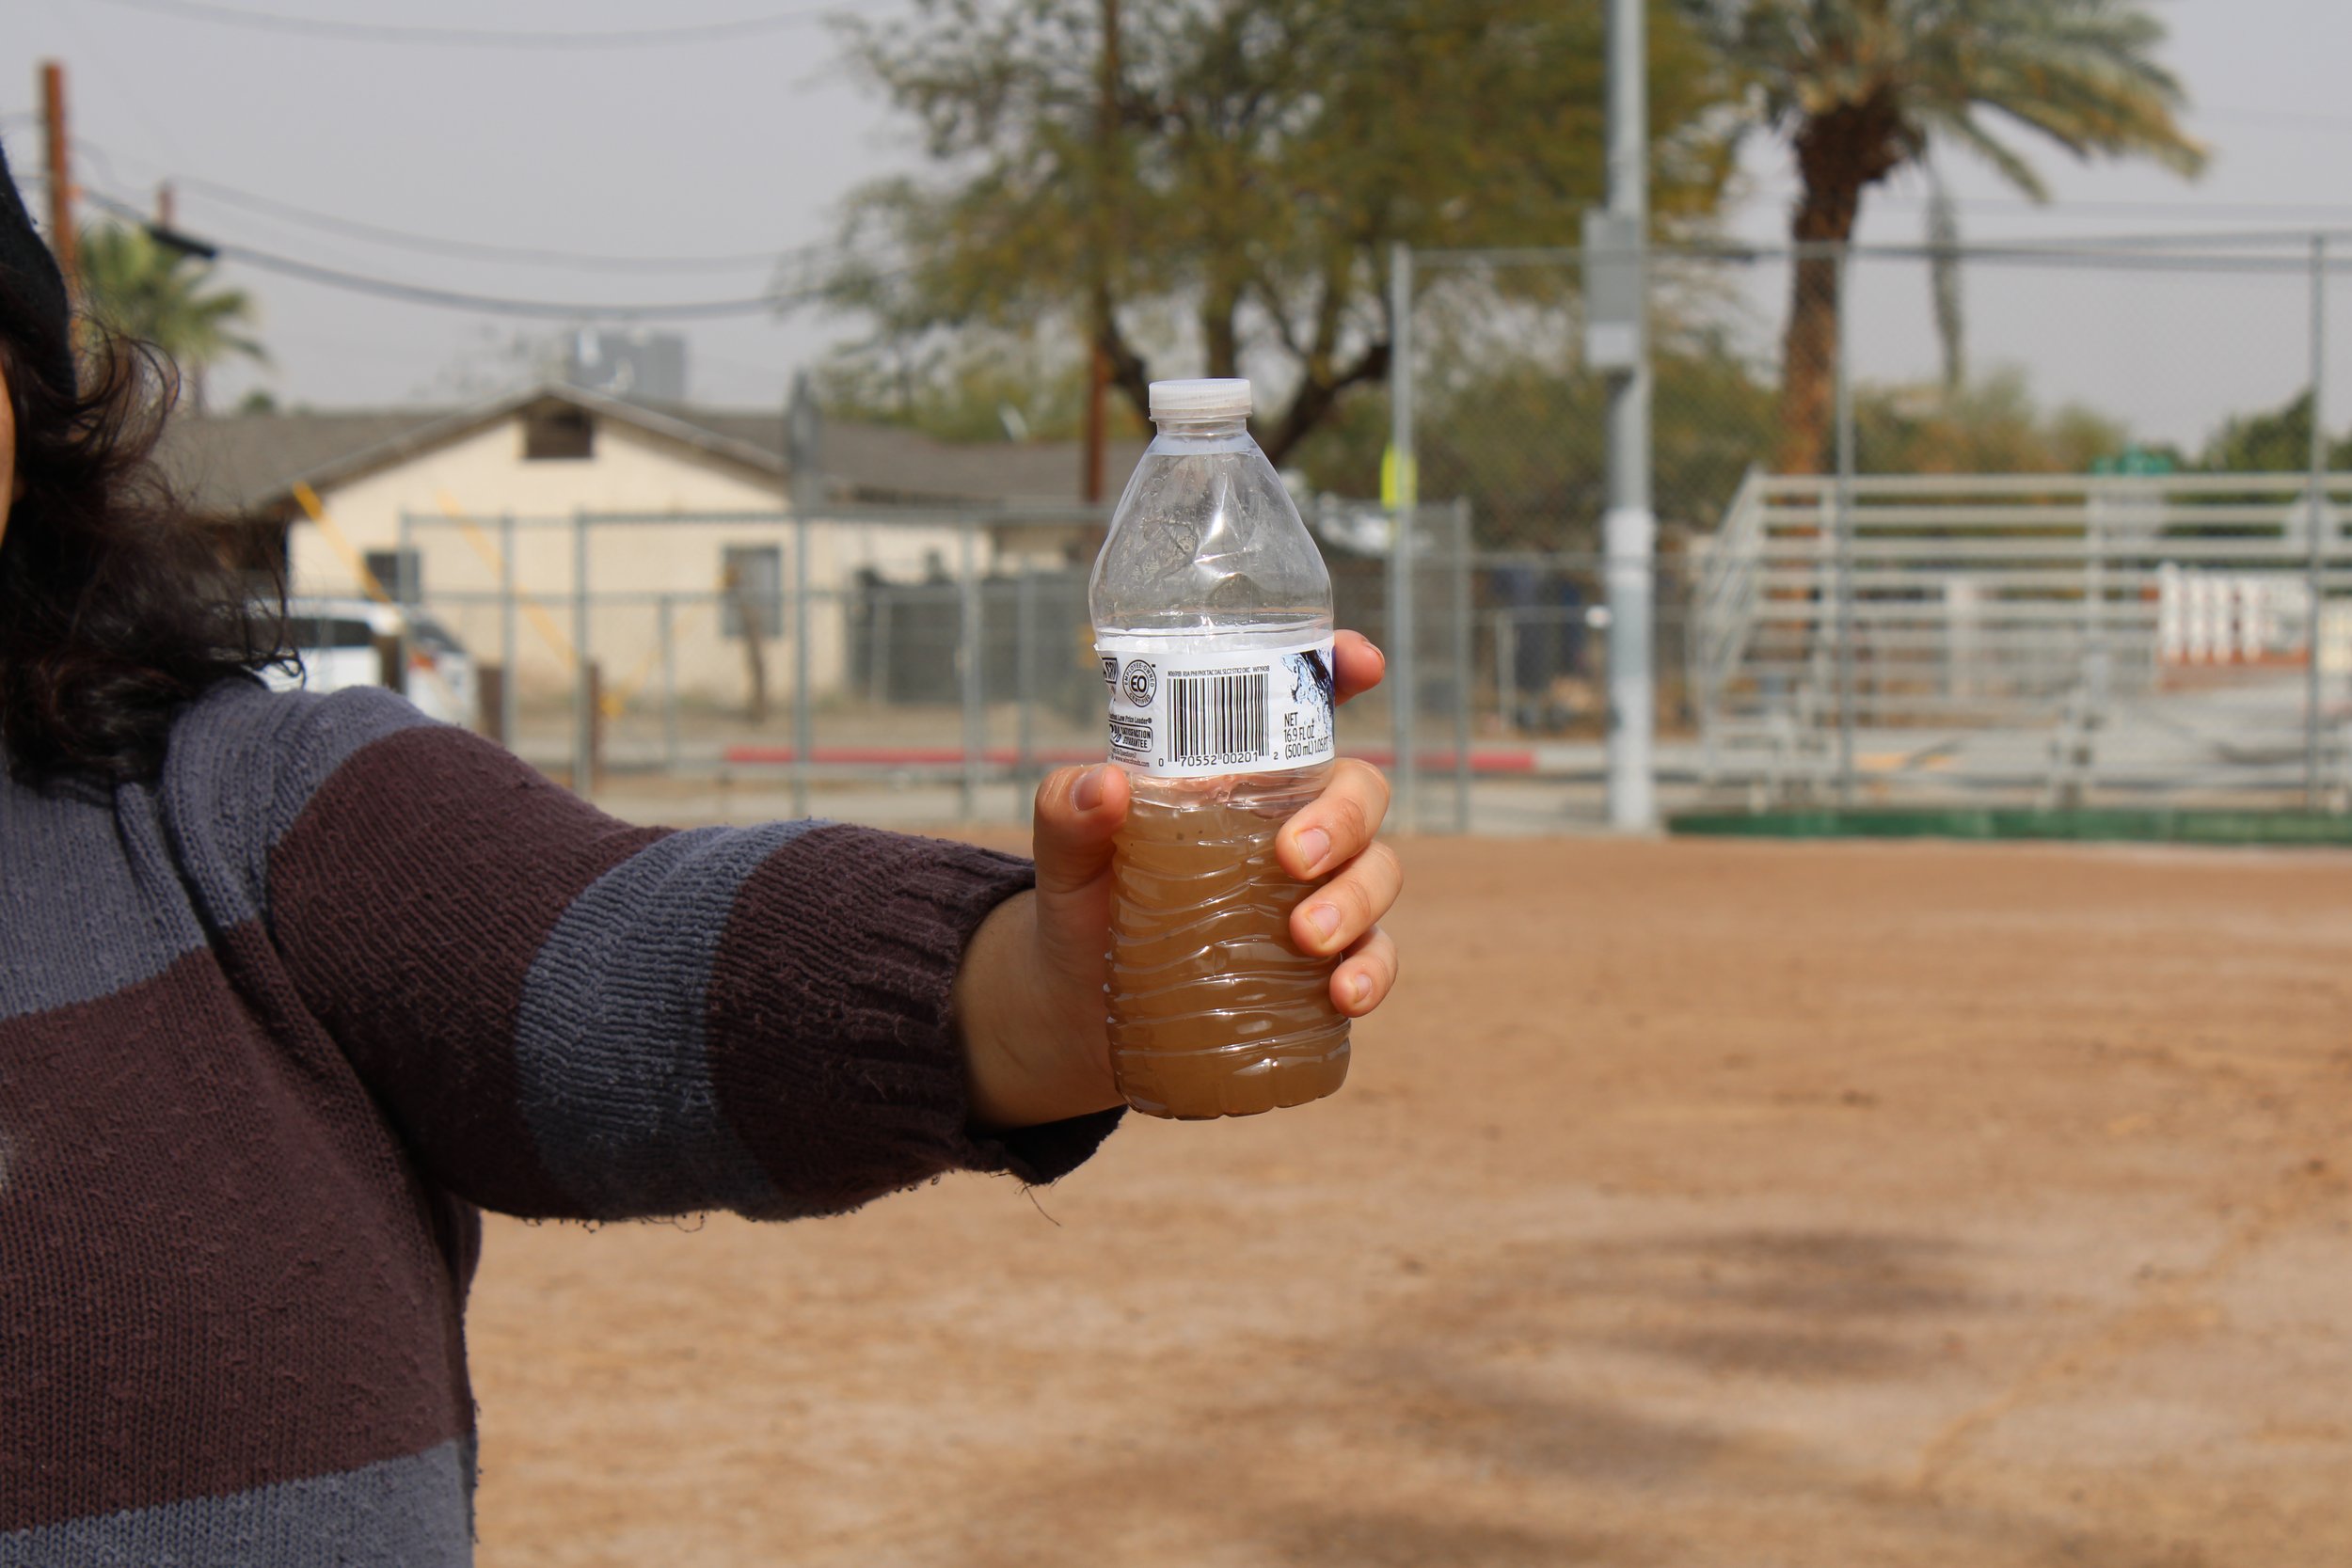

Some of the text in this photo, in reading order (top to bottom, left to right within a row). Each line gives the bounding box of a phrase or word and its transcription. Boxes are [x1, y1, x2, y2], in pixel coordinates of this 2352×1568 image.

[1131, 675, 1147, 692] EO
[1284, 711, 1298, 727] NET
[1284, 724, 1314, 742] 16.9 FL OZ
[1285, 742, 1301, 760] (500
[1303, 740, 1313, 755] mL)
[1181, 754, 1216, 767] 70552
[1223, 752, 1258, 764] 00201
[1273, 752, 1279, 760] 2
